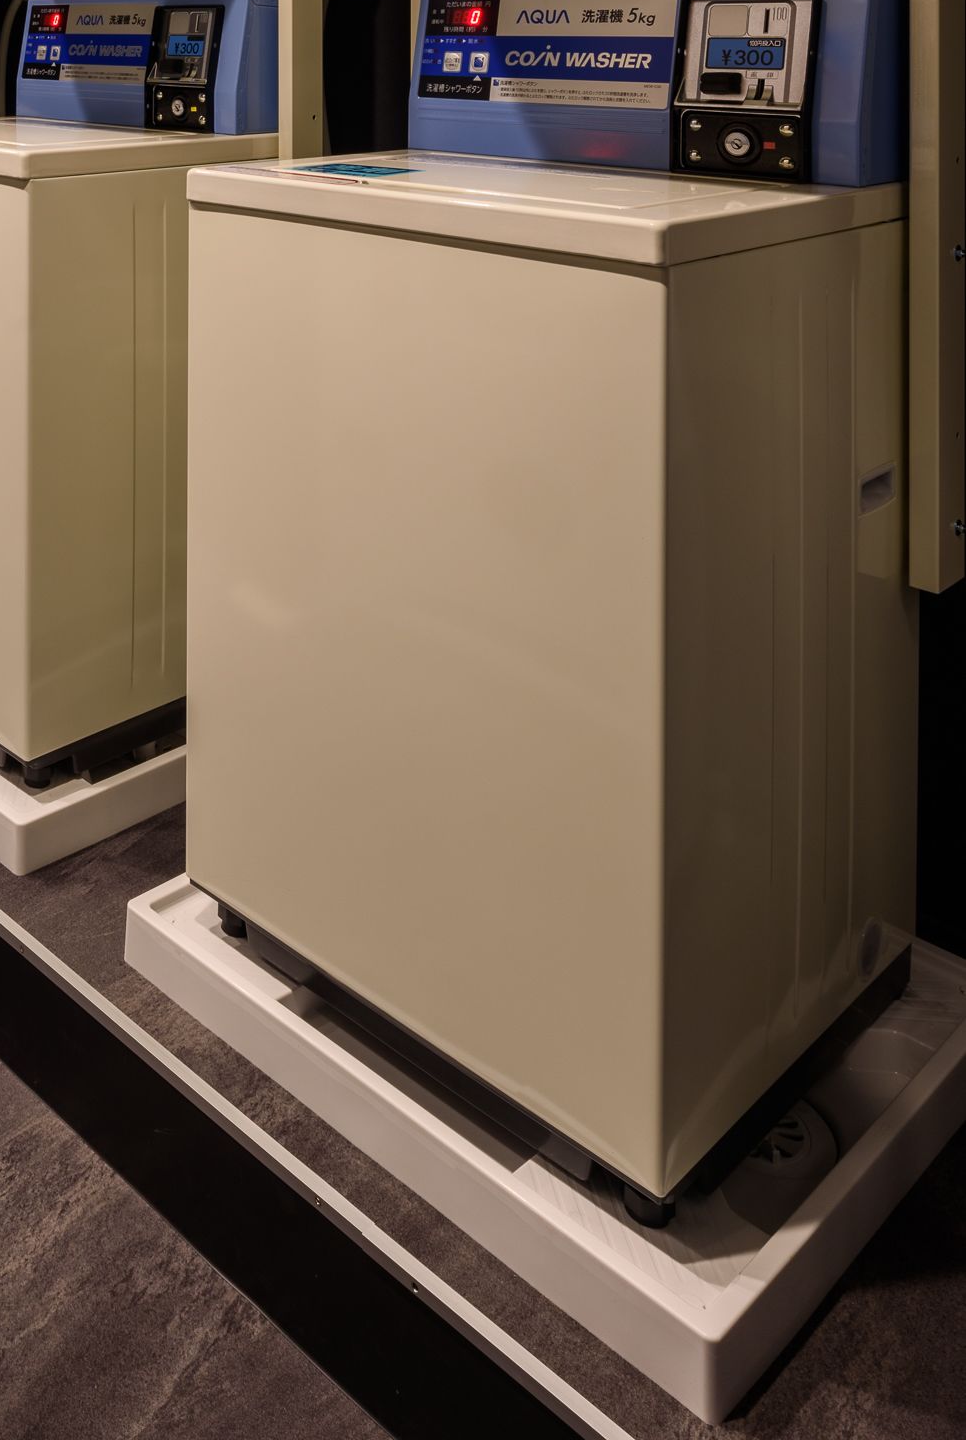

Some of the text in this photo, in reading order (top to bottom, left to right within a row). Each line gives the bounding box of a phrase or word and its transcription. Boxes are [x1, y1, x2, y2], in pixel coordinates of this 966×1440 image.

[53, 15, 60, 26] 0
[76, 14, 146, 28] AQUA 洗濯機 5kg
[471, 10, 480, 24] 0
[516, 7, 656, 26] AQUA 洗濯機 5kg
[772, 7, 788, 21] 100
[99, 45, 143, 57] WASHER
[174, 43, 200, 54] ¥300
[566, 52, 652, 70] WASHER
[721, 49, 774, 66] ¥300
[426, 83, 483, 94] 洗濯槽シャワーボタン
